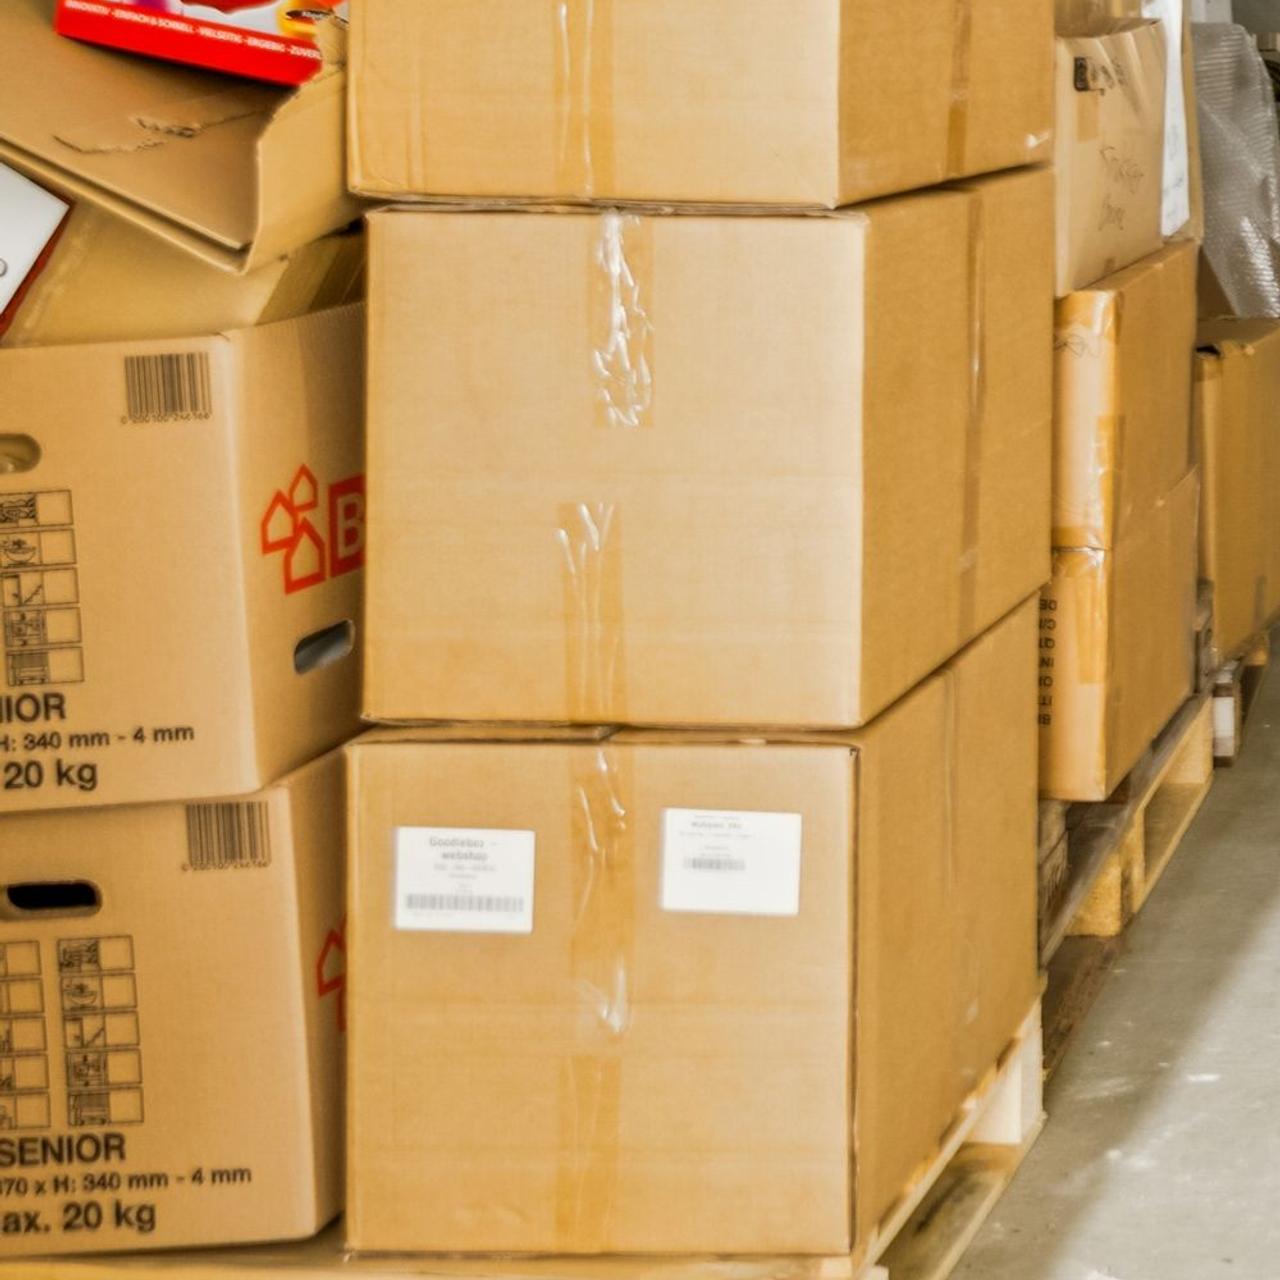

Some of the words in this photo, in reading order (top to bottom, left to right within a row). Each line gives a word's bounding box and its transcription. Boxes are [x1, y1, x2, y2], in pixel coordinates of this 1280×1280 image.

[0, 691, 66, 723] IOR
[23, 731, 62, 751] 340
[68, 731, 110, 748] mm
[132, 726, 146, 744] 4
[153, 726, 195, 742] mm
[4, 760, 43, 790] 20
[56, 758, 98, 792] kg
[0, 1132, 126, 1167] SENIOR
[34, 1181, 47, 1195] x
[53, 1176, 76, 1194] H:
[83, 1173, 121, 1192] 340
[128, 1171, 168, 1189] mm
[191, 1167, 205, 1185] 4
[211, 1167, 252, 1184] mm
[62, 1201, 103, 1232] 20
[114, 1199, 156, 1234] kg
